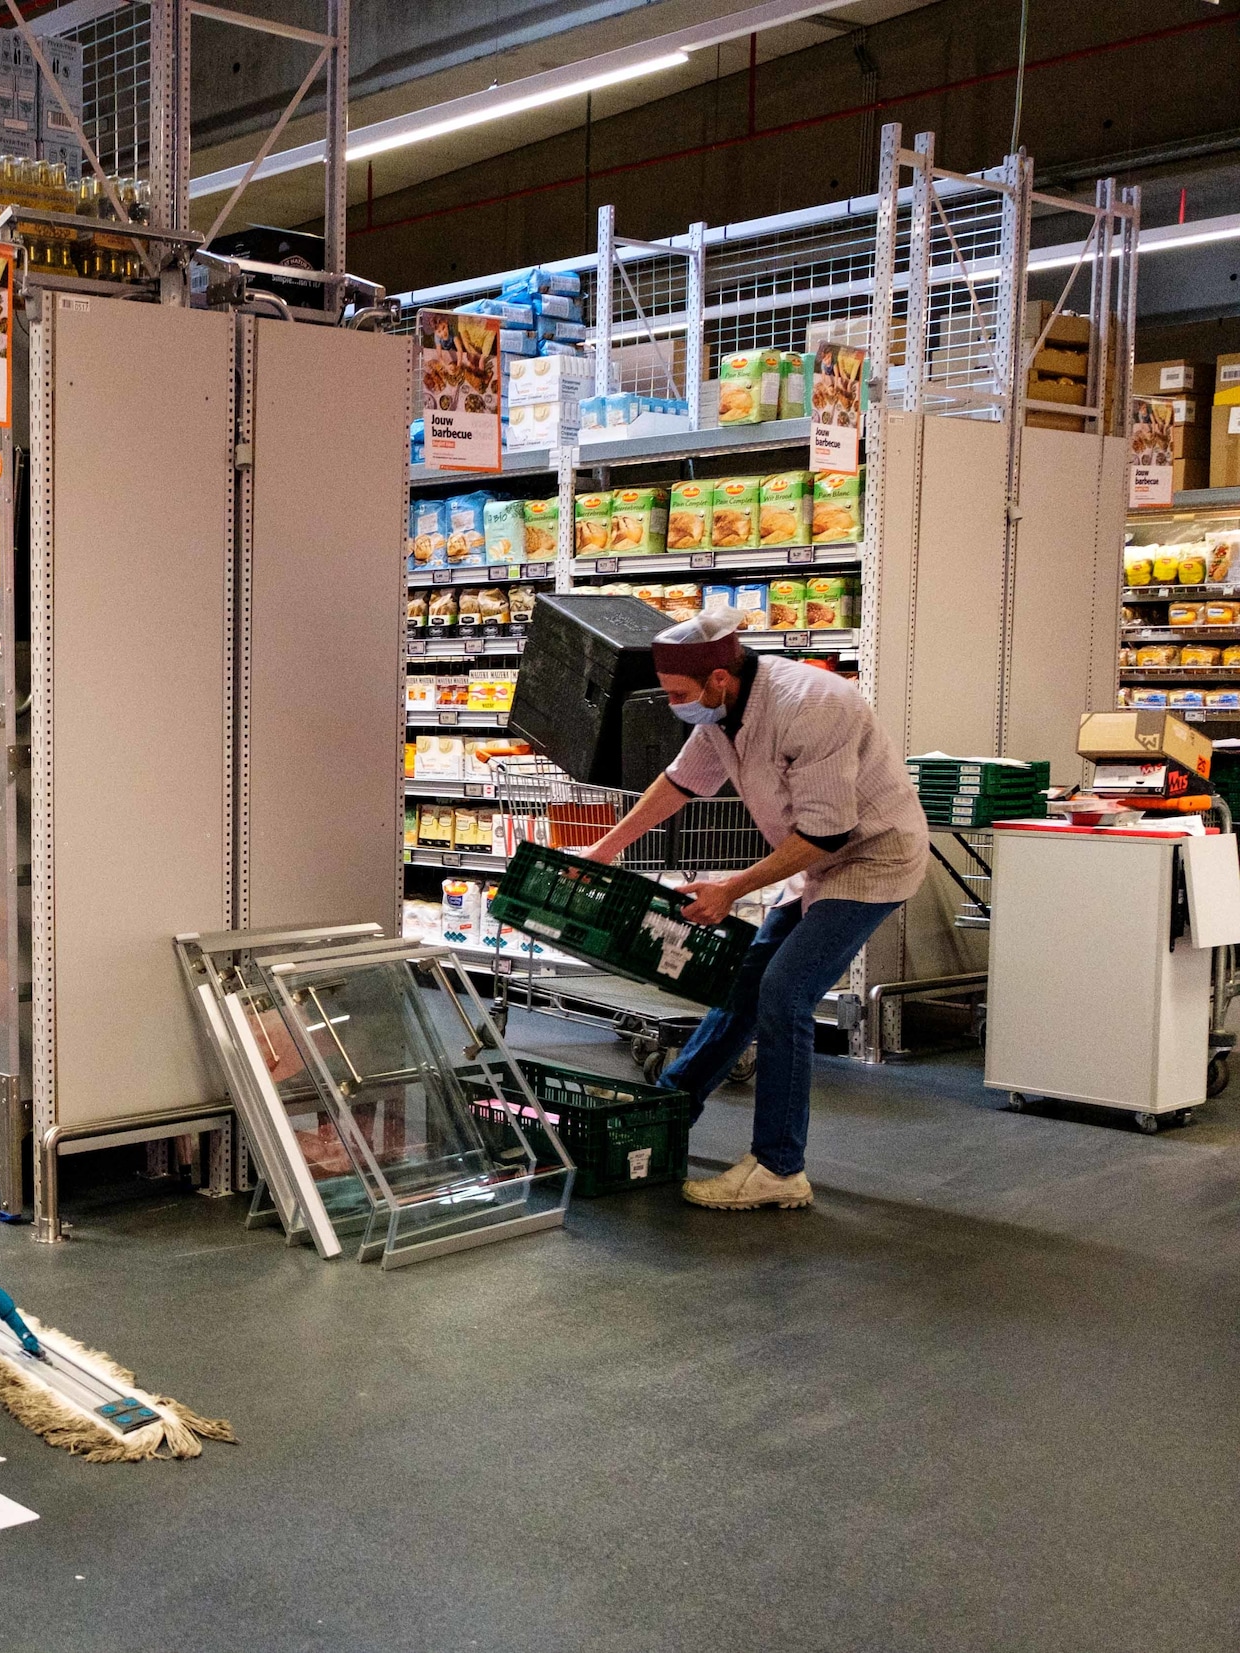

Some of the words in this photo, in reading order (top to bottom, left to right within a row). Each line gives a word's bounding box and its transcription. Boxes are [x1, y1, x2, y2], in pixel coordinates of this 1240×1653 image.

[431, 414, 454, 426] Jouw
[432, 426, 472, 440] barbecue
[815, 427, 830, 437] Jouw
[815, 436, 841, 449] barbecue
[1134, 477, 1159, 486] barbecue
